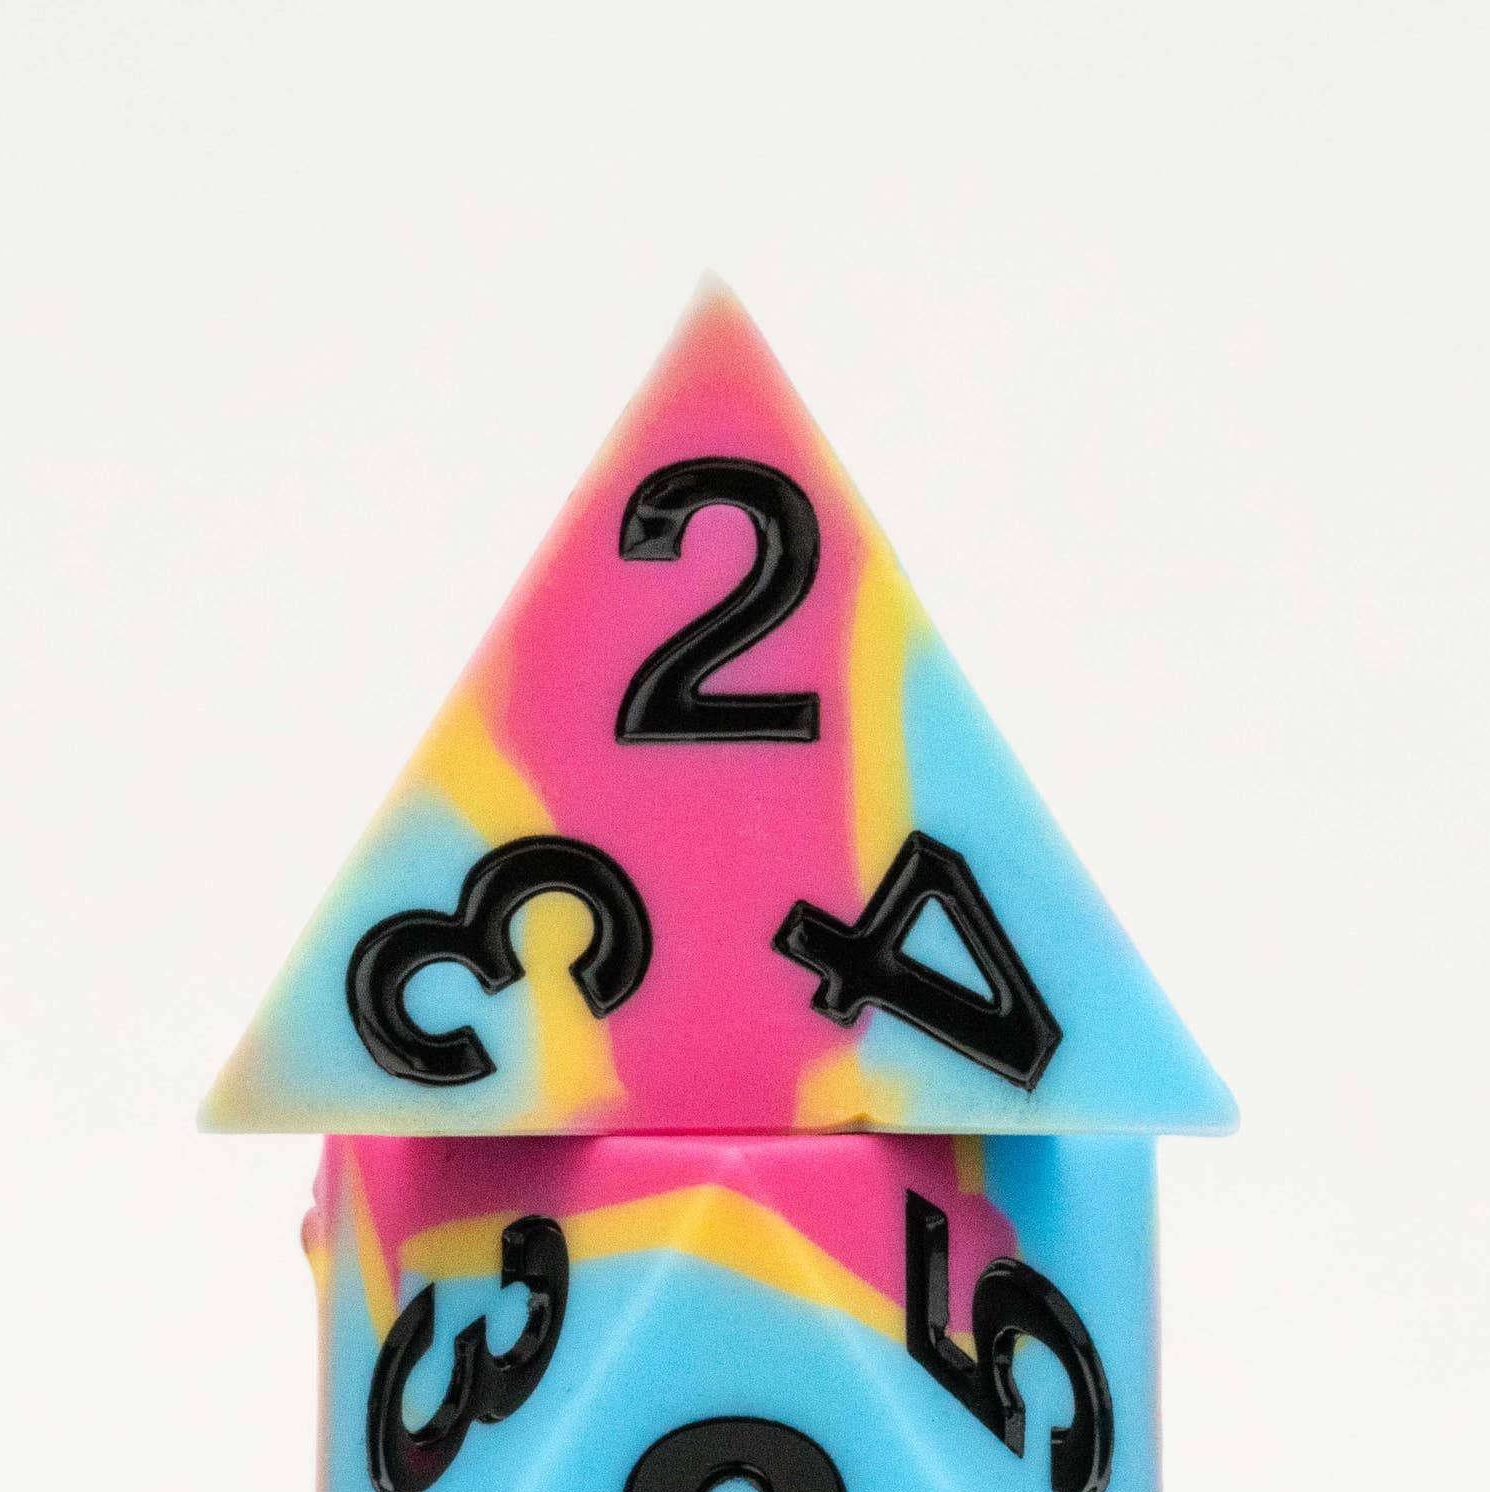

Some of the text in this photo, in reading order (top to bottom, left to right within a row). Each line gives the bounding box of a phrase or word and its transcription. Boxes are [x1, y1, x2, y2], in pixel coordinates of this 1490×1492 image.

[615, 457, 820, 744] 2
[346, 836, 653, 1088] 3
[772, 831, 1064, 1093] 4
